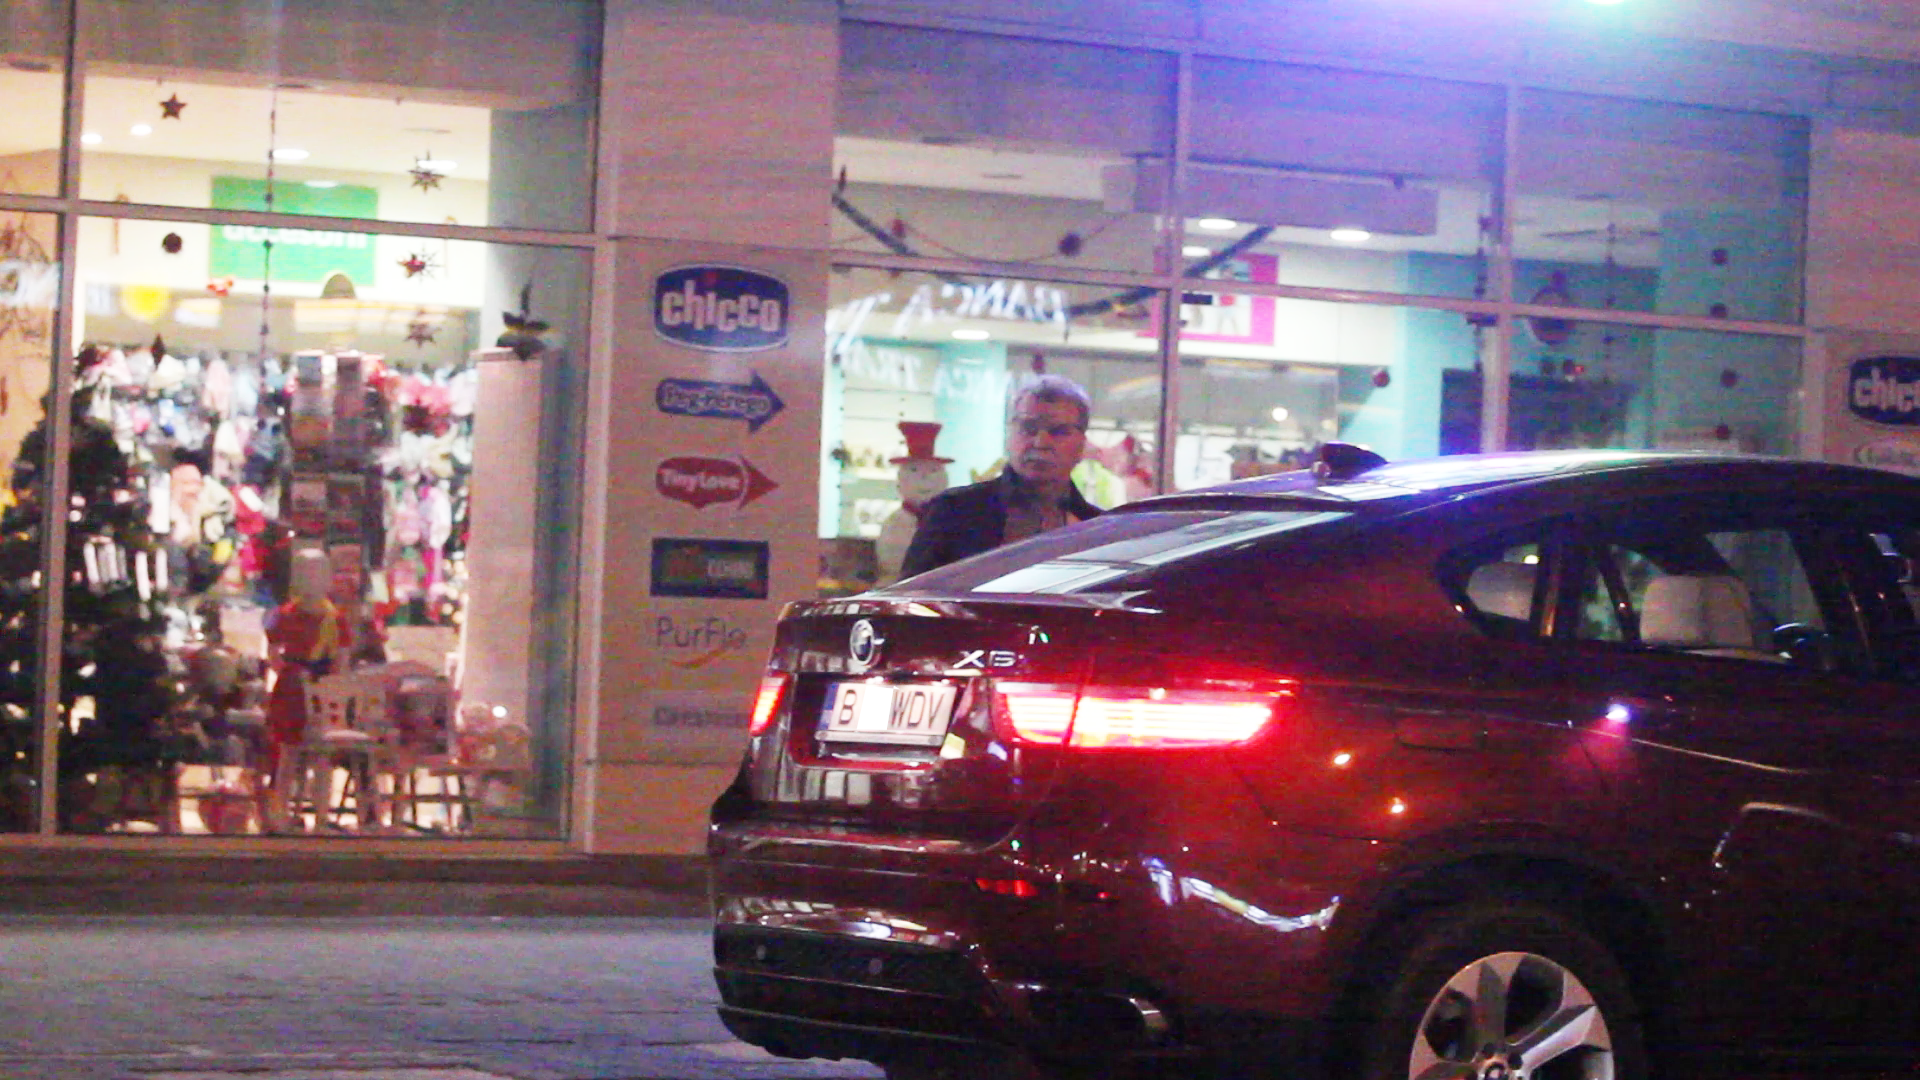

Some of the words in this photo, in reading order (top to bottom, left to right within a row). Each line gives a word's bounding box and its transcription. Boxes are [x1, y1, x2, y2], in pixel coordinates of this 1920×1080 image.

[661, 271, 781, 332] chicco
[952, 650, 1016, 668] X6
[838, 689, 857, 725] B
[890, 691, 945, 728] WDV
